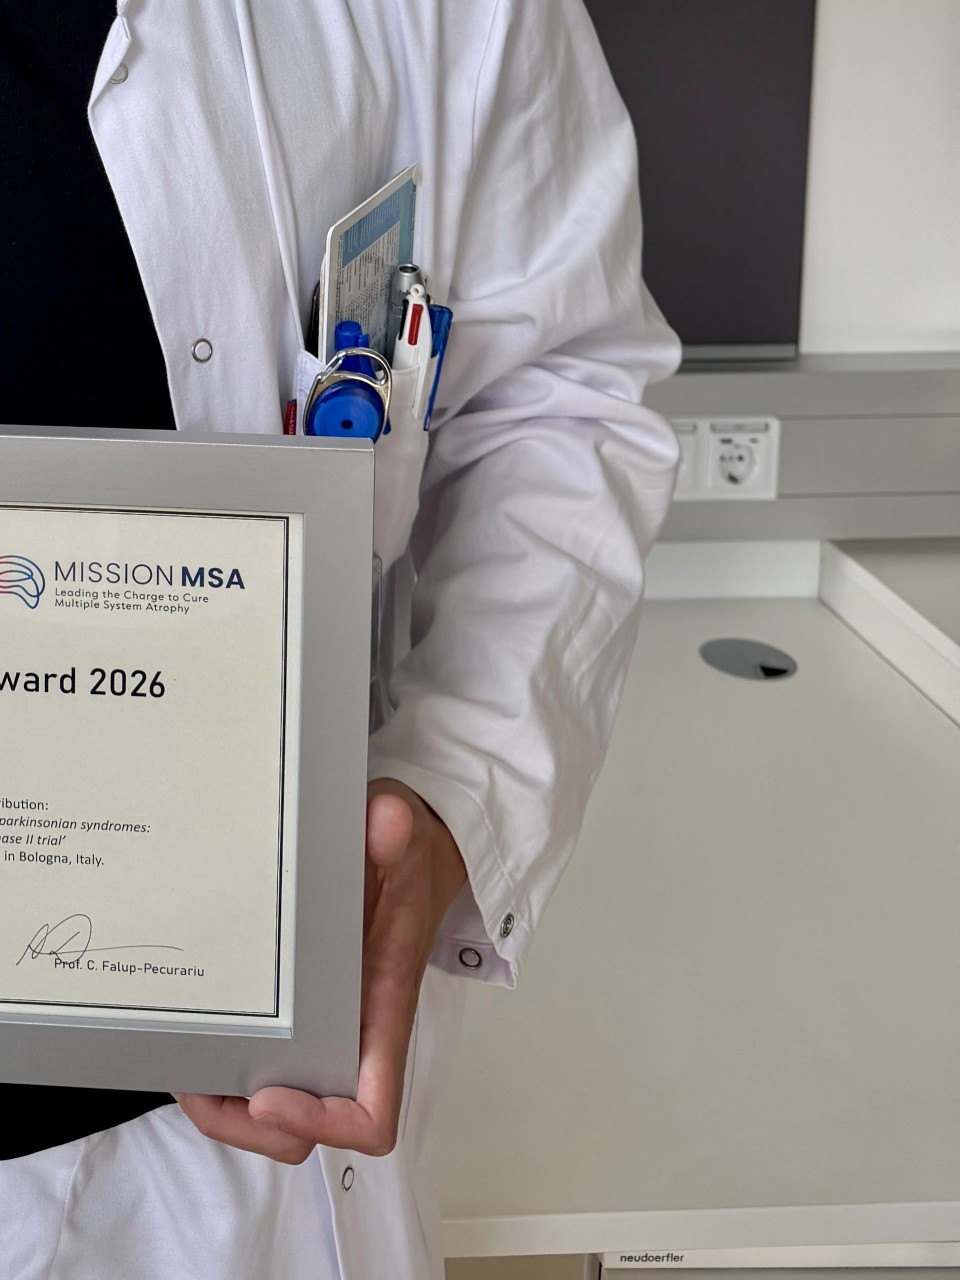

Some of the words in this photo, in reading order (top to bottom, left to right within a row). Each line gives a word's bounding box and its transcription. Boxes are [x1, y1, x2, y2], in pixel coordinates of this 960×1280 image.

[55, 561, 173, 586] MISSION
[181, 566, 246, 589] MSA
[55, 588, 99, 601] Leading
[102, 589, 121, 600] the
[124, 591, 164, 603] Charge
[168, 593, 179, 602] to
[182, 593, 209, 603] Cure
[55, 598, 100, 610] Multiple
[103, 600, 142, 612] System
[145, 602, 190, 615] Atrophy
[89, 667, 166, 698] 2026
[80, 819, 151, 833] syndromes:
[25, 834, 33, 844] II
[4, 850, 15, 861] in
[19, 851, 73, 865] Bologna,
[76, 854, 105, 867] Italy.
[54, 958, 83, 969] Prof.
[86, 960, 98, 970] C.
[102, 961, 205, 976] Falup-Pecurariu
[620, 1253, 685, 1263] neudoerfler
